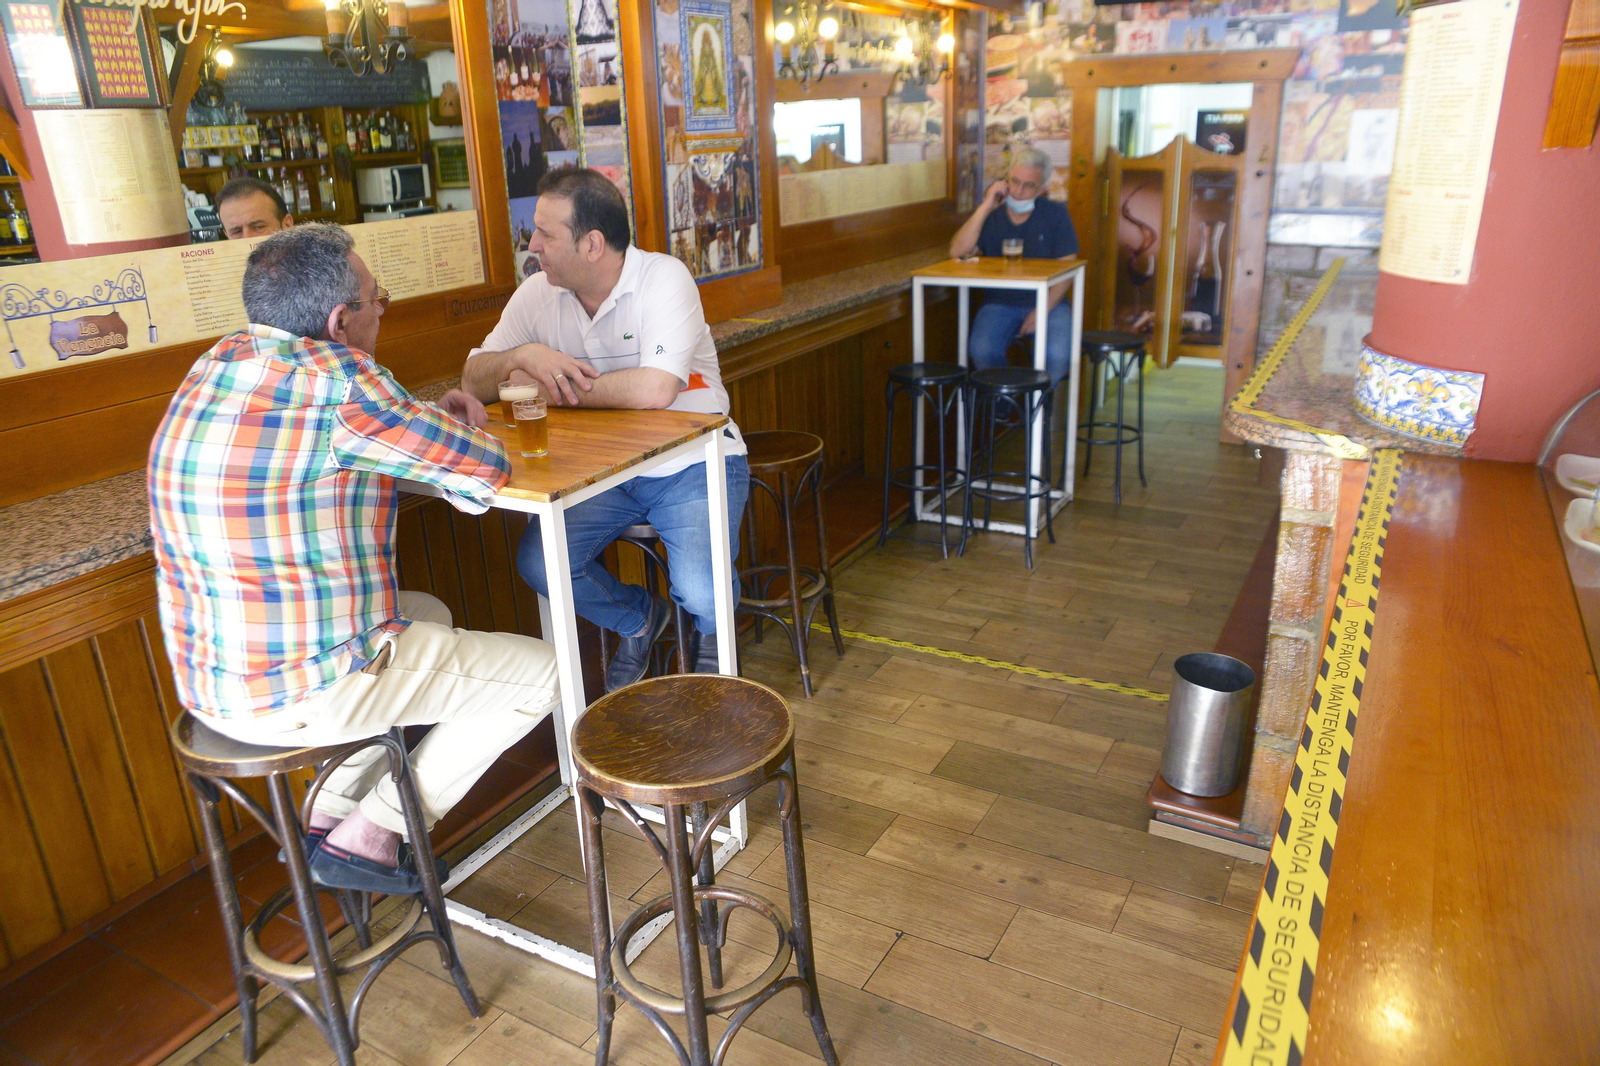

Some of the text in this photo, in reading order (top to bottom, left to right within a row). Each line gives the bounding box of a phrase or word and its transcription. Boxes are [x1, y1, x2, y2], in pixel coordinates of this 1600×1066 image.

[181, 248, 214, 258] RACIONES
[78, 321, 99, 336] La
[55, 331, 126, 356] Venencia
[1365, 501, 1383, 530] DISTANCIA
[1363, 531, 1376, 541] DE
[1354, 541, 1373, 585] SEGURIDAD
[1251, 619, 1359, 1066] POR FAVOR, MANTENGA LA DISTANCIA DE SEGURIDAD
